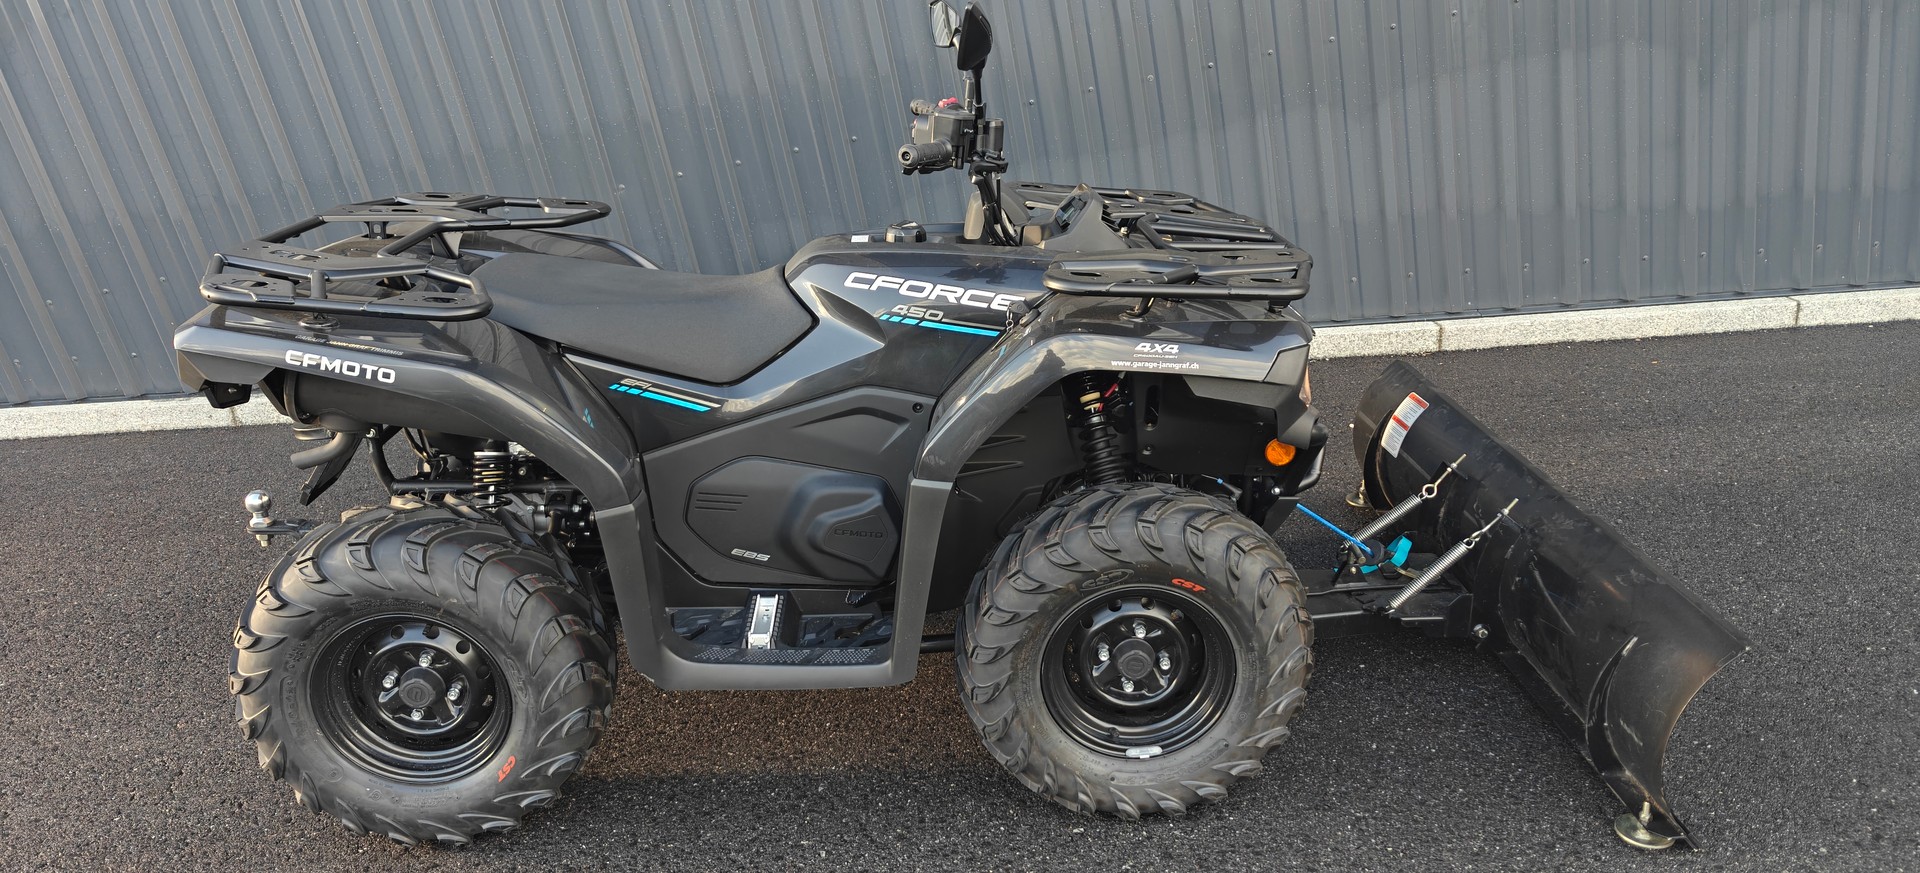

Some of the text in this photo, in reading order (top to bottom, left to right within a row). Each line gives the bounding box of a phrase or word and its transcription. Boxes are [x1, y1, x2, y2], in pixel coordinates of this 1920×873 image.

[843, 271, 1026, 311] CFORCE
[891, 304, 944, 321] 450
[285, 349, 396, 384] CFMOTO
[1111, 360, 1200, 370] www.garage-janngraf.ch
[620, 378, 652, 389] EFI
[833, 528, 884, 539] CFMOTO
[731, 548, 771, 561] EBS
[1171, 578, 1206, 592] CST
[497, 755, 516, 783] CST
